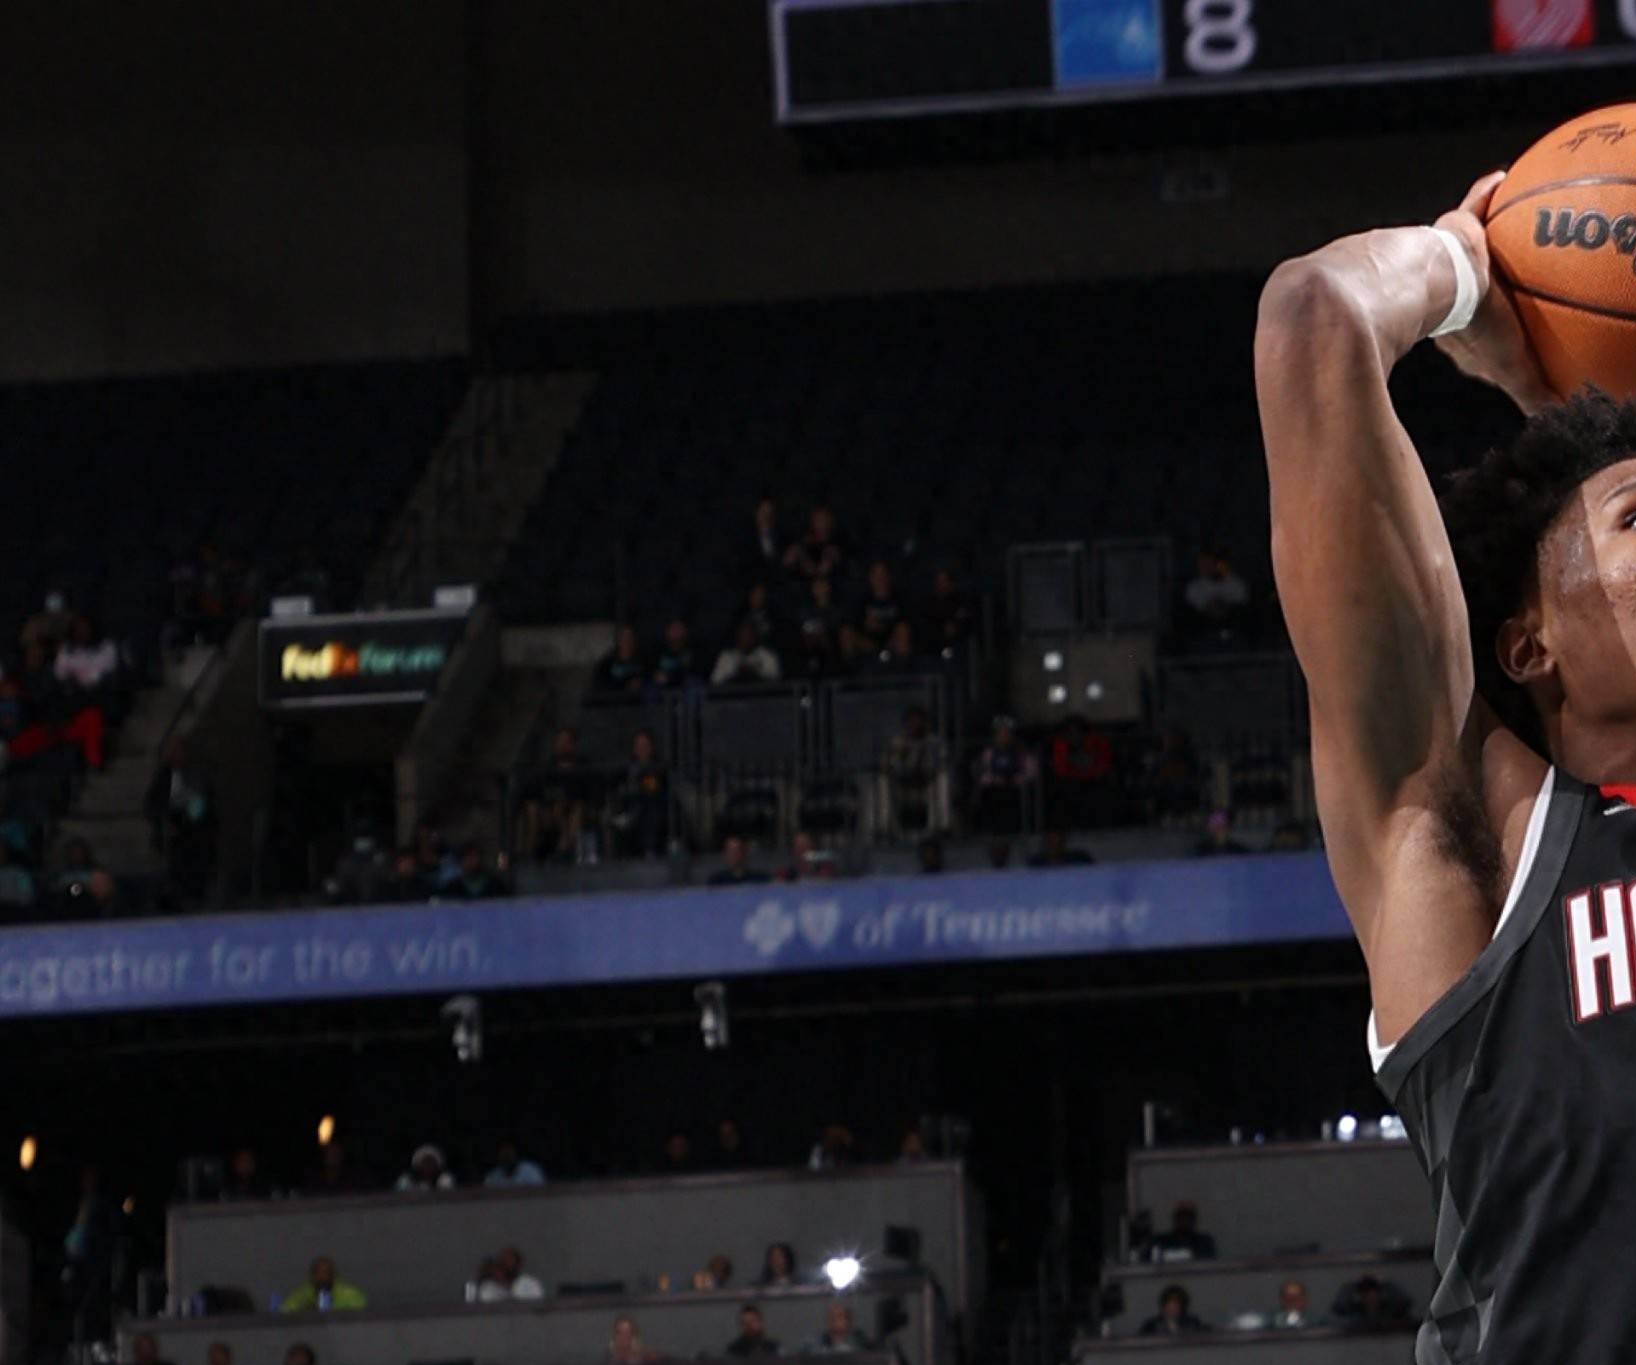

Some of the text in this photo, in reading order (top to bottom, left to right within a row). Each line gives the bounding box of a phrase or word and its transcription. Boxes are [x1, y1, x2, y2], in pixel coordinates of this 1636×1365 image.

[853, 898, 1152, 948] of Tennessee
[0, 944, 190, 1003] ogether
[210, 938, 275, 985] for
[291, 933, 373, 981] the
